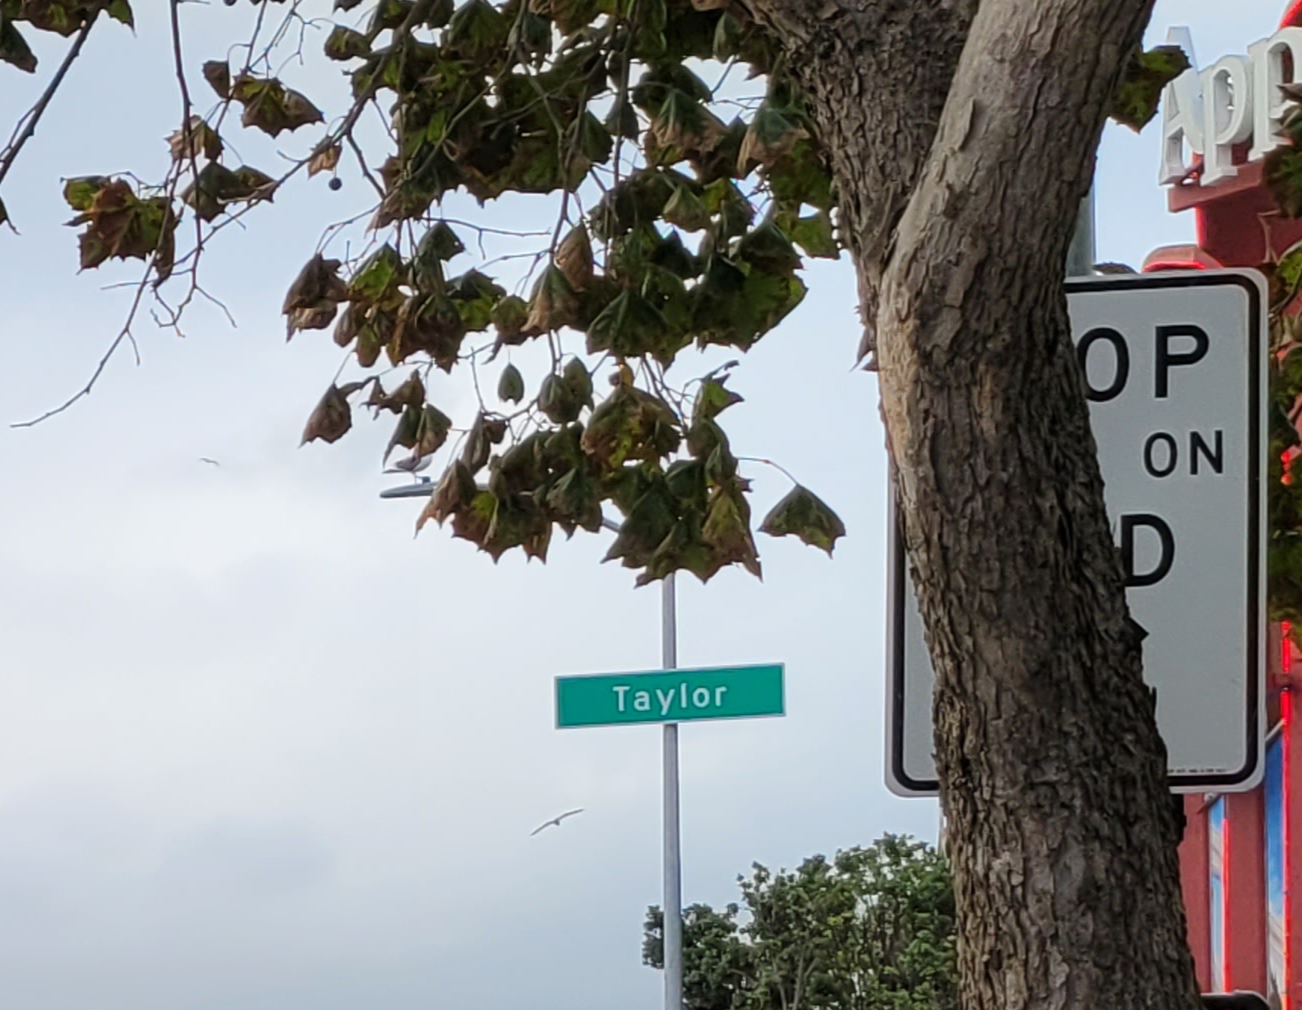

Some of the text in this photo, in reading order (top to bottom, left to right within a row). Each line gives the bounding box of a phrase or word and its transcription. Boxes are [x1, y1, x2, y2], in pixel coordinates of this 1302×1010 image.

[1159, 27, 1302, 186] App
[1077, 325, 1209, 402] OP
[1144, 430, 1223, 478] ON
[612, 682, 727, 716] Taylor
